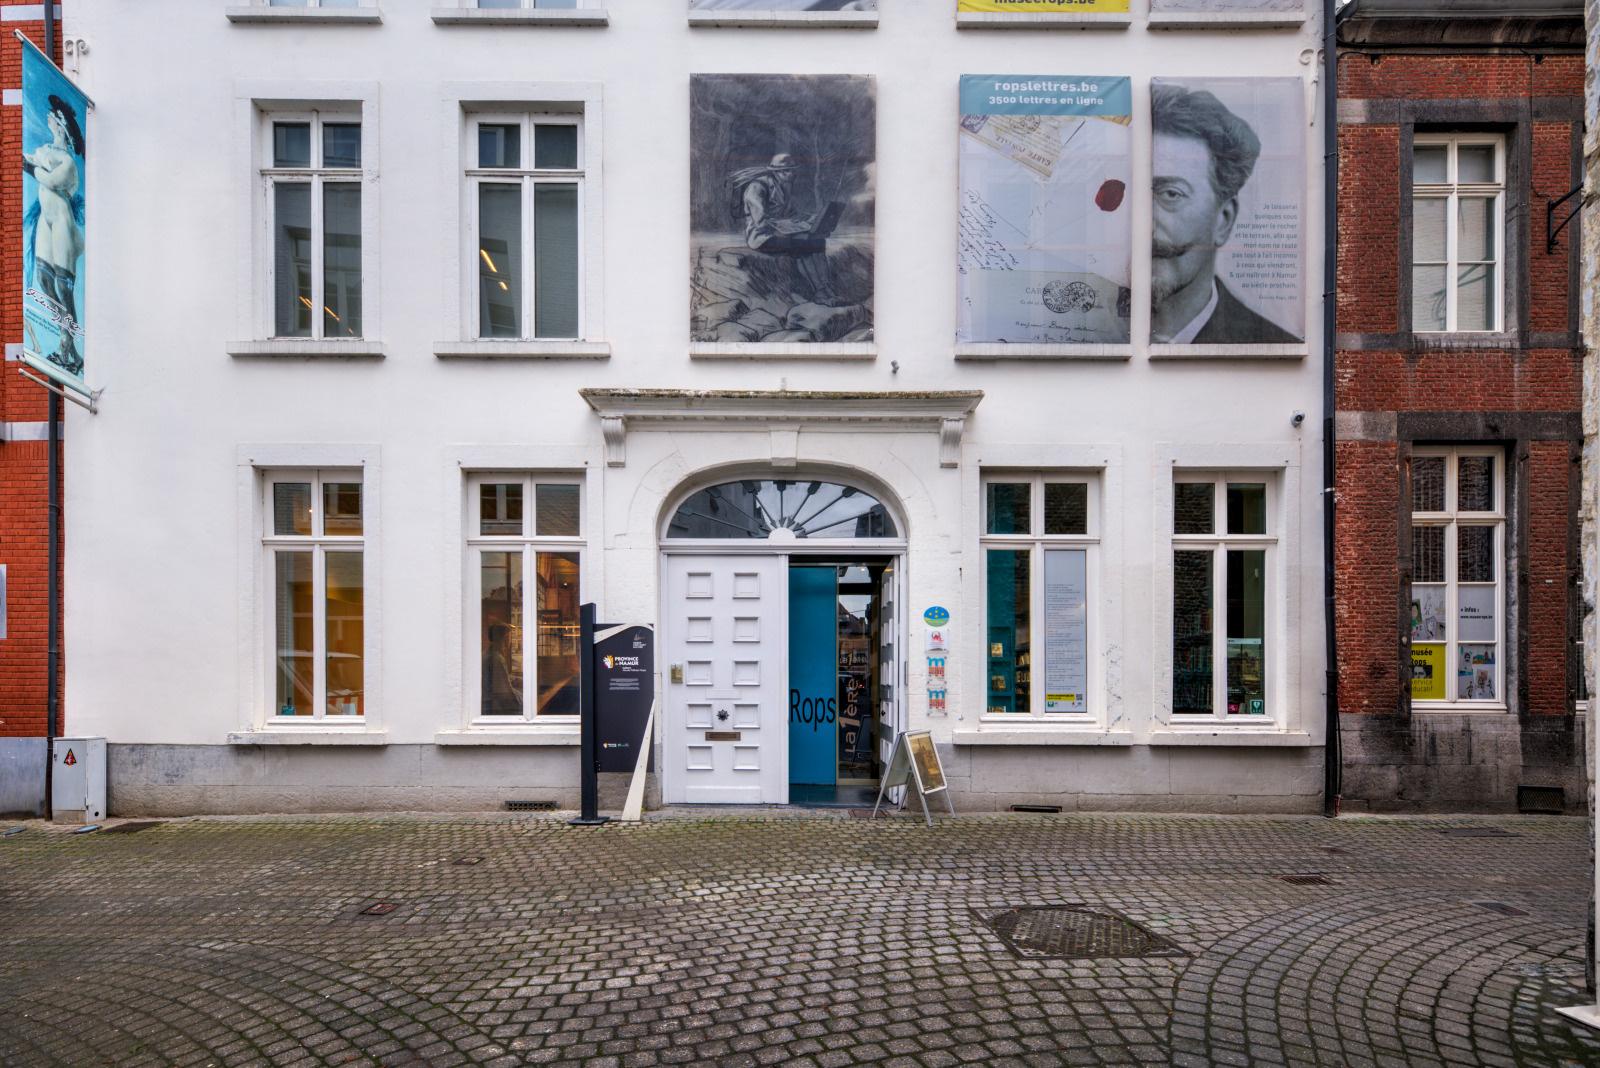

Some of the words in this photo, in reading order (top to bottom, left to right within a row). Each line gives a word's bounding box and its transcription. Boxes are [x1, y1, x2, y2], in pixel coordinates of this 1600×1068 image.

[994, 81, 1098, 93] ropslettres.be
[989, 96, 1017, 105] 3500
[1019, 95, 1058, 104] lettres
[1060, 97, 1074, 105] en
[1076, 96, 1104, 106] ligne
[790, 688, 837, 732] Rops
